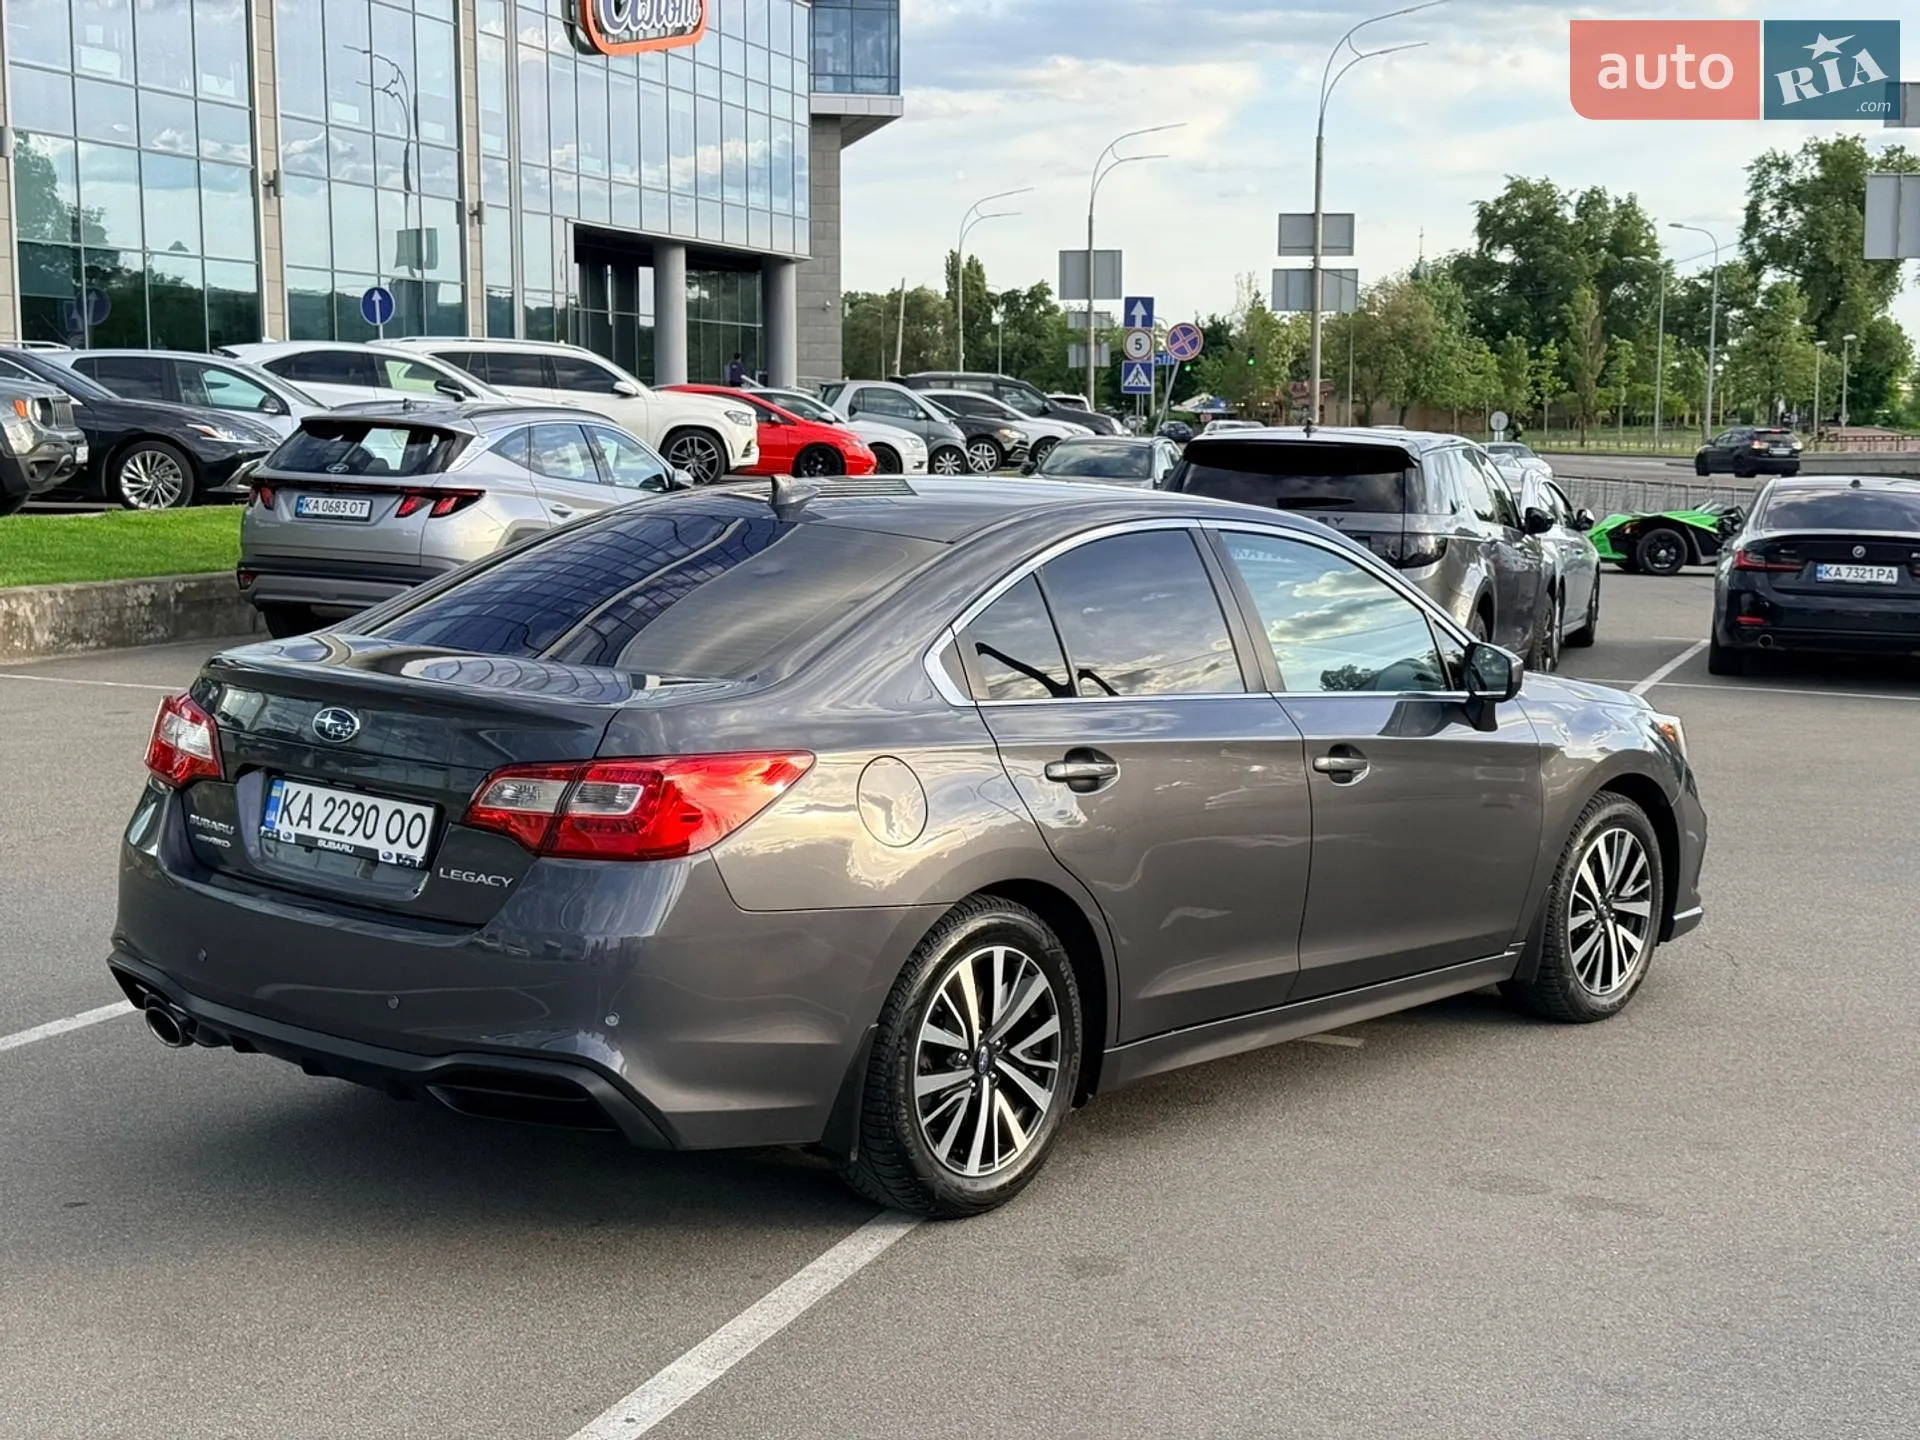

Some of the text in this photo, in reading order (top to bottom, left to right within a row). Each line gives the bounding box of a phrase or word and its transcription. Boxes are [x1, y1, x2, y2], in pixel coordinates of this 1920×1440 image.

[1134, 338, 1143, 351] 5
[304, 499, 367, 514] KA 0683 OT
[1824, 566, 1895, 580] KA 7321 PA
[279, 788, 313, 829] KA
[318, 796, 380, 841] 2290
[317, 839, 355, 854] SUBARU
[439, 867, 514, 888] LEGACY
